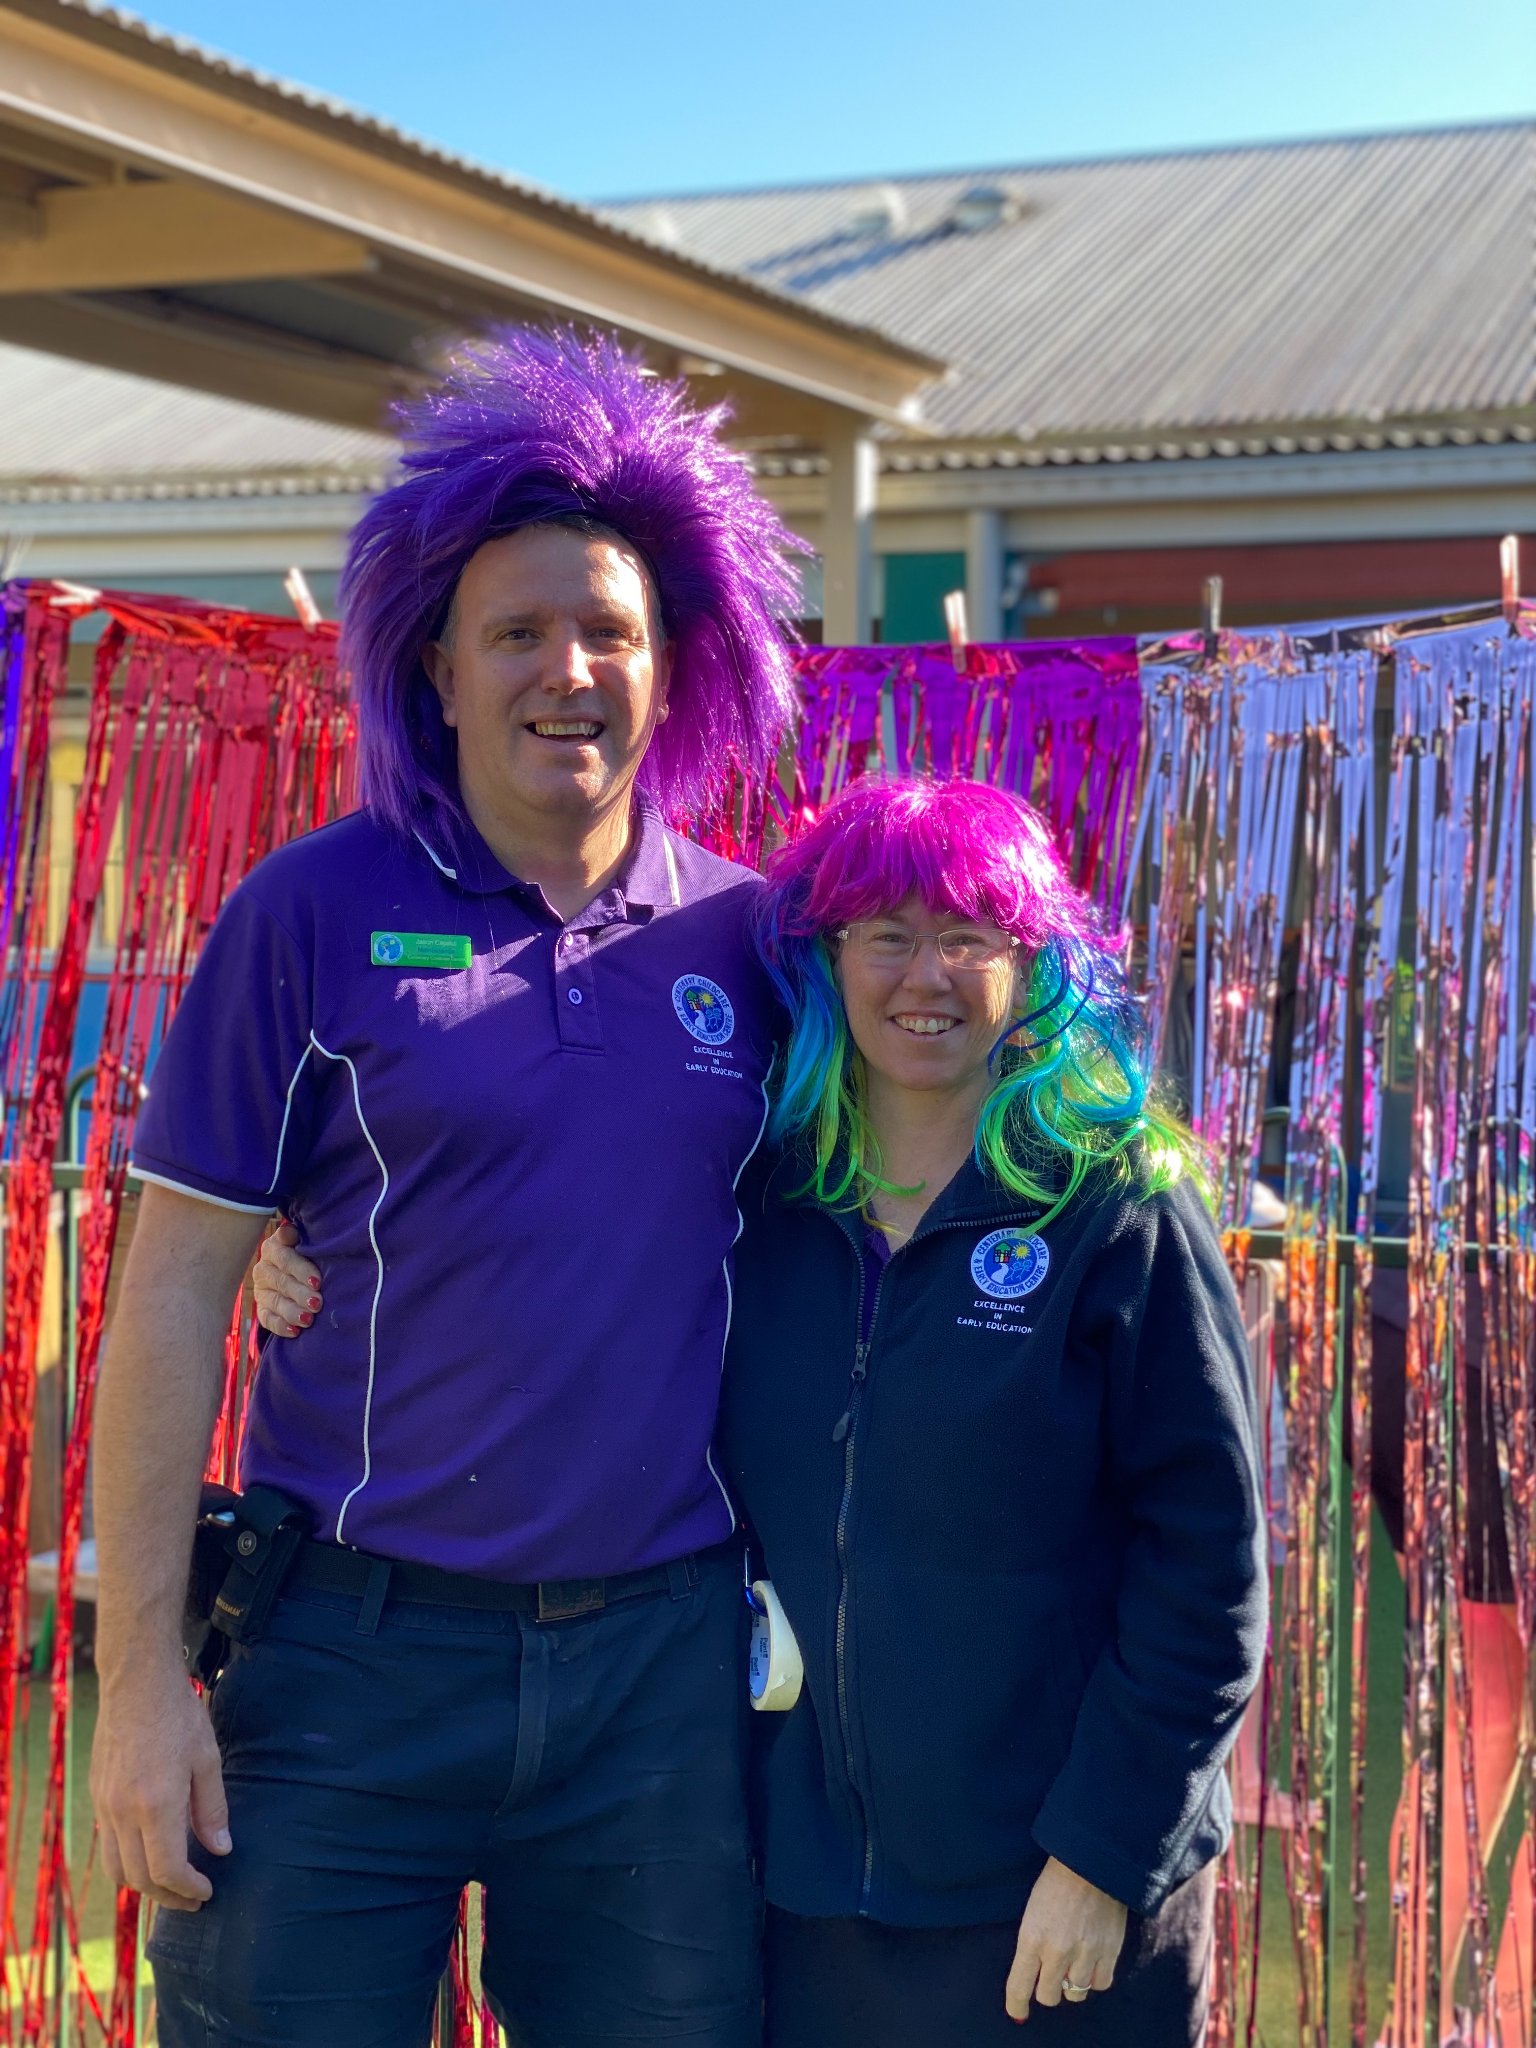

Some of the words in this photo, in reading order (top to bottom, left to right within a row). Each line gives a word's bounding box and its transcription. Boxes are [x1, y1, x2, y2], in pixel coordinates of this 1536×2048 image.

[698, 978, 729, 1008] CHILDCARE
[693, 1045, 733, 1058] EXCELLENCE
[712, 1057, 720, 1065] IN
[685, 1062, 708, 1072] EARLY
[710, 1066, 743, 1079] EDUCATION
[977, 1229, 1016, 1255] CENTENARY
[974, 1266, 988, 1285] EARLY
[986, 1282, 1026, 1295] EDUCATION
[1024, 1264, 1046, 1289] CENTRE
[974, 1300, 1026, 1313] EXCELLENCE
[957, 1317, 983, 1328] EARLY
[986, 1321, 1034, 1334] EDUCATION
